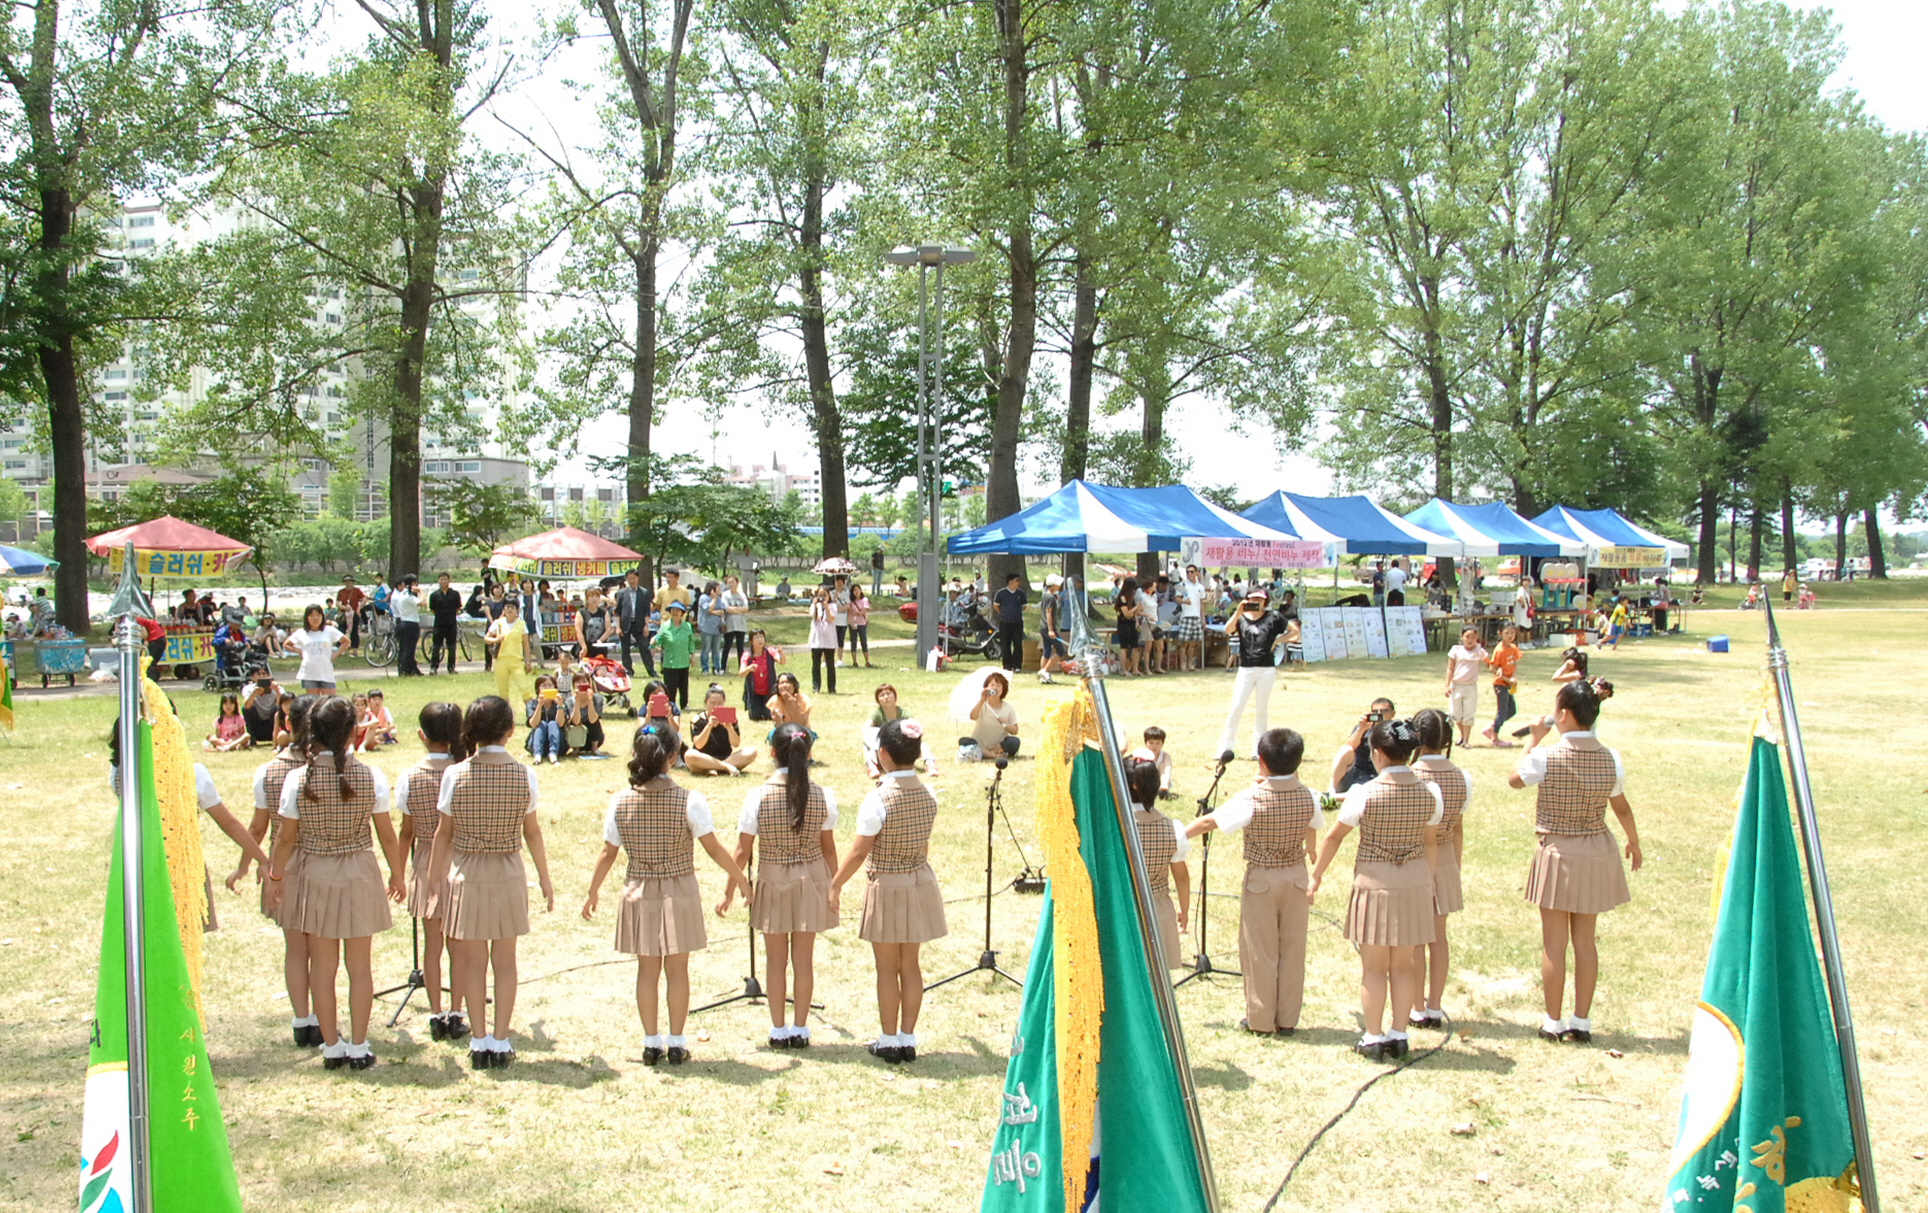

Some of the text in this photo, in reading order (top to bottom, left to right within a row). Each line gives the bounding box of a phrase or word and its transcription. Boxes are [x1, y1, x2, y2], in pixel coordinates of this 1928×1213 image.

[1206, 547, 1234, 560] 재활용
[1263, 549, 1298, 561] 천연비누
[1302, 550, 1320, 562] 제작
[543, 561, 572, 575] 슬러쉬
[576, 561, 606, 575] 냉커피
